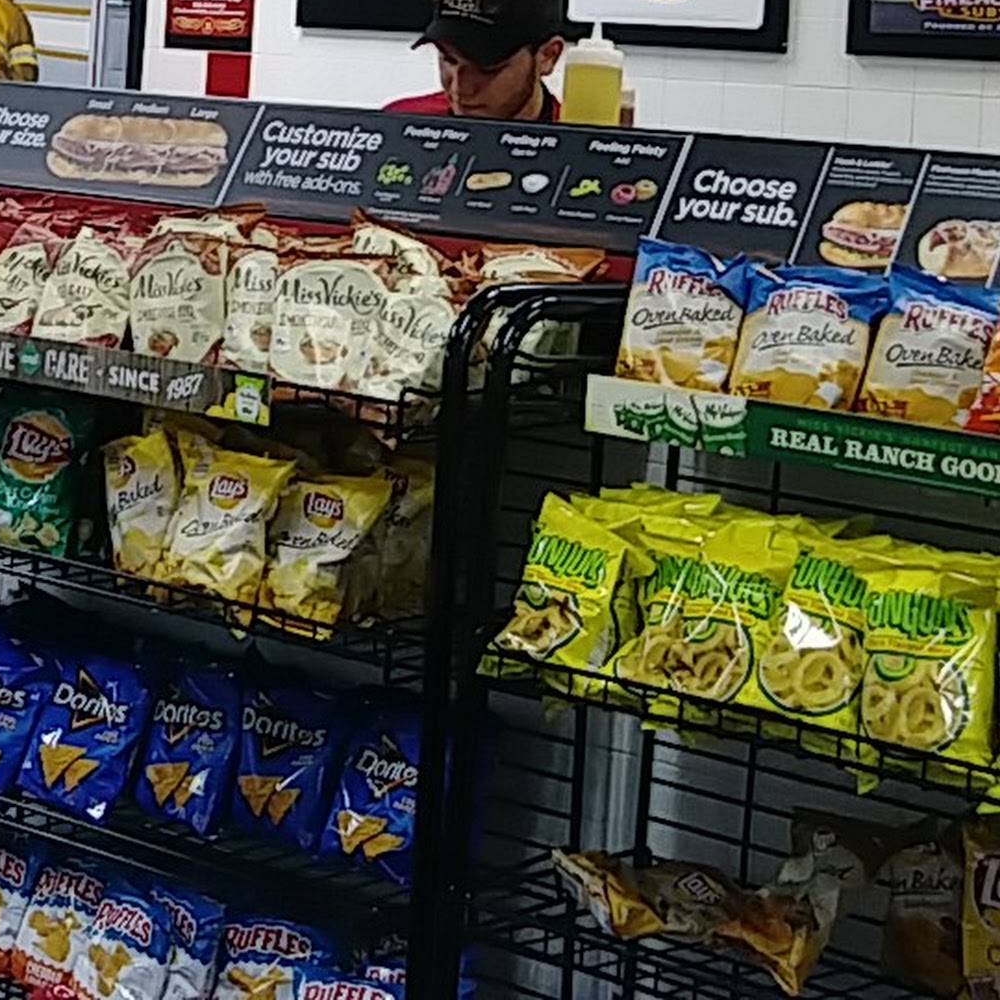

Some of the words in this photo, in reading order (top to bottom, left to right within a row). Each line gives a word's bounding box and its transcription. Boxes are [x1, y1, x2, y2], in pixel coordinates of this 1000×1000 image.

[190, 107, 219, 120] Large
[12, 128, 47, 148] size.
[262, 120, 384, 151] Customize
[500, 133, 540, 147] Feeling
[589, 140, 630, 155] Feeling
[259, 145, 317, 169] your
[316, 149, 362, 173] sub
[244, 169, 273, 185] with
[273, 170, 302, 189] free
[693, 169, 798, 200] Choose
[674, 195, 742, 222] your
[740, 199, 799, 227] sub.
[275, 276, 322, 307] Miss
[319, 274, 383, 316] Vickie's
[767, 288, 849, 325] RUFFLES
[797, 324, 857, 346] Baked
[885, 342, 935, 368] Oven
[937, 346, 985, 371] Bake
[43, 348, 92, 387] CARE
[108, 364, 161, 394] SINCE
[165, 372, 205, 402] 1987
[769, 427, 839, 457] REAL
[844, 438, 937, 473] RANCH
[210, 474, 249, 499] Lay's
[306, 493, 345, 521] Lay's
[53, 682, 131, 725] Doritos
[153, 699, 225, 731] Doritos
[241, 707, 327, 748] Doritos
[35, 866, 105, 909] RUFFLES
[95, 897, 154, 948] RUFFLES
[223, 923, 313, 961] RUFFLES
